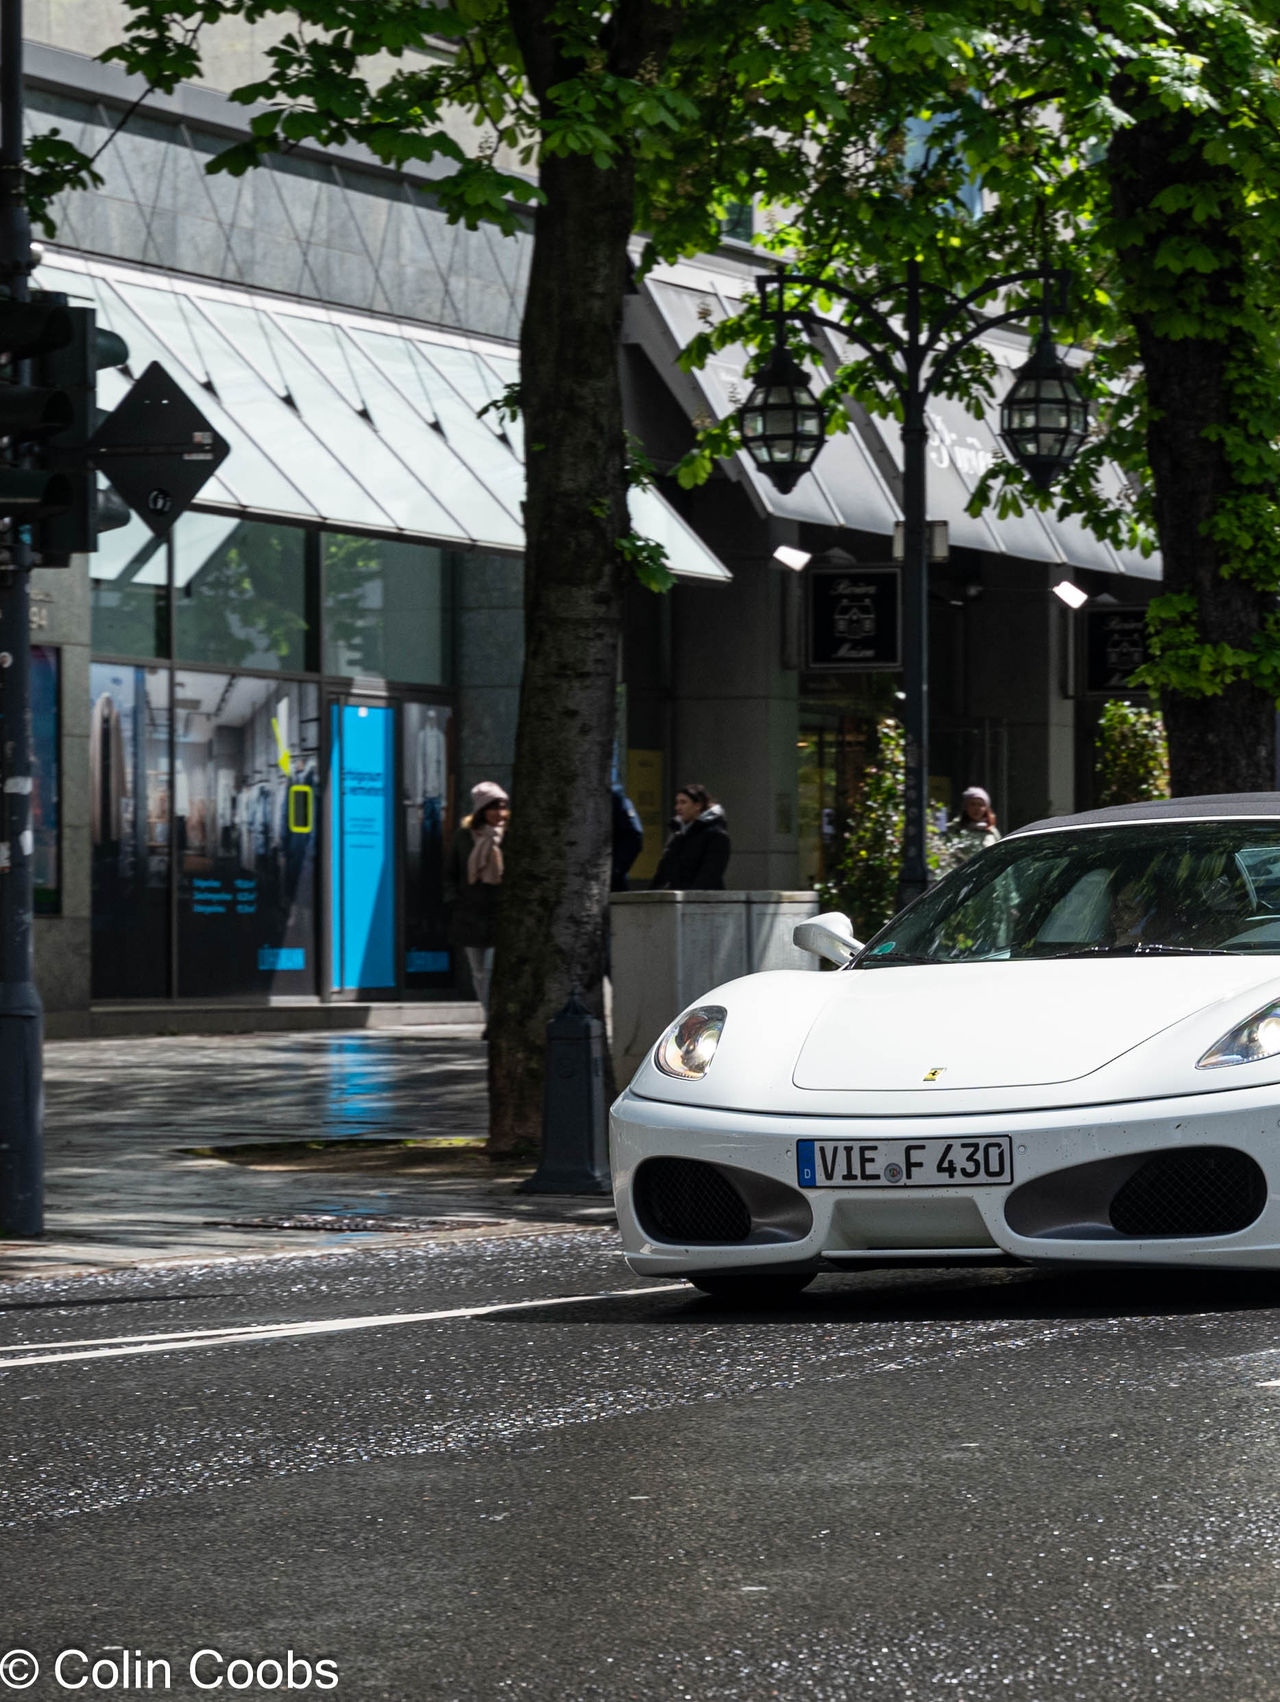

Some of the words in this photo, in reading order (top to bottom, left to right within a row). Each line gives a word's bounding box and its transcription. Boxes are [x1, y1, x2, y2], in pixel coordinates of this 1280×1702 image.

[819, 1145, 881, 1181] VIE
[904, 1144, 926, 1180] F
[936, 1142, 1005, 1178] 430
